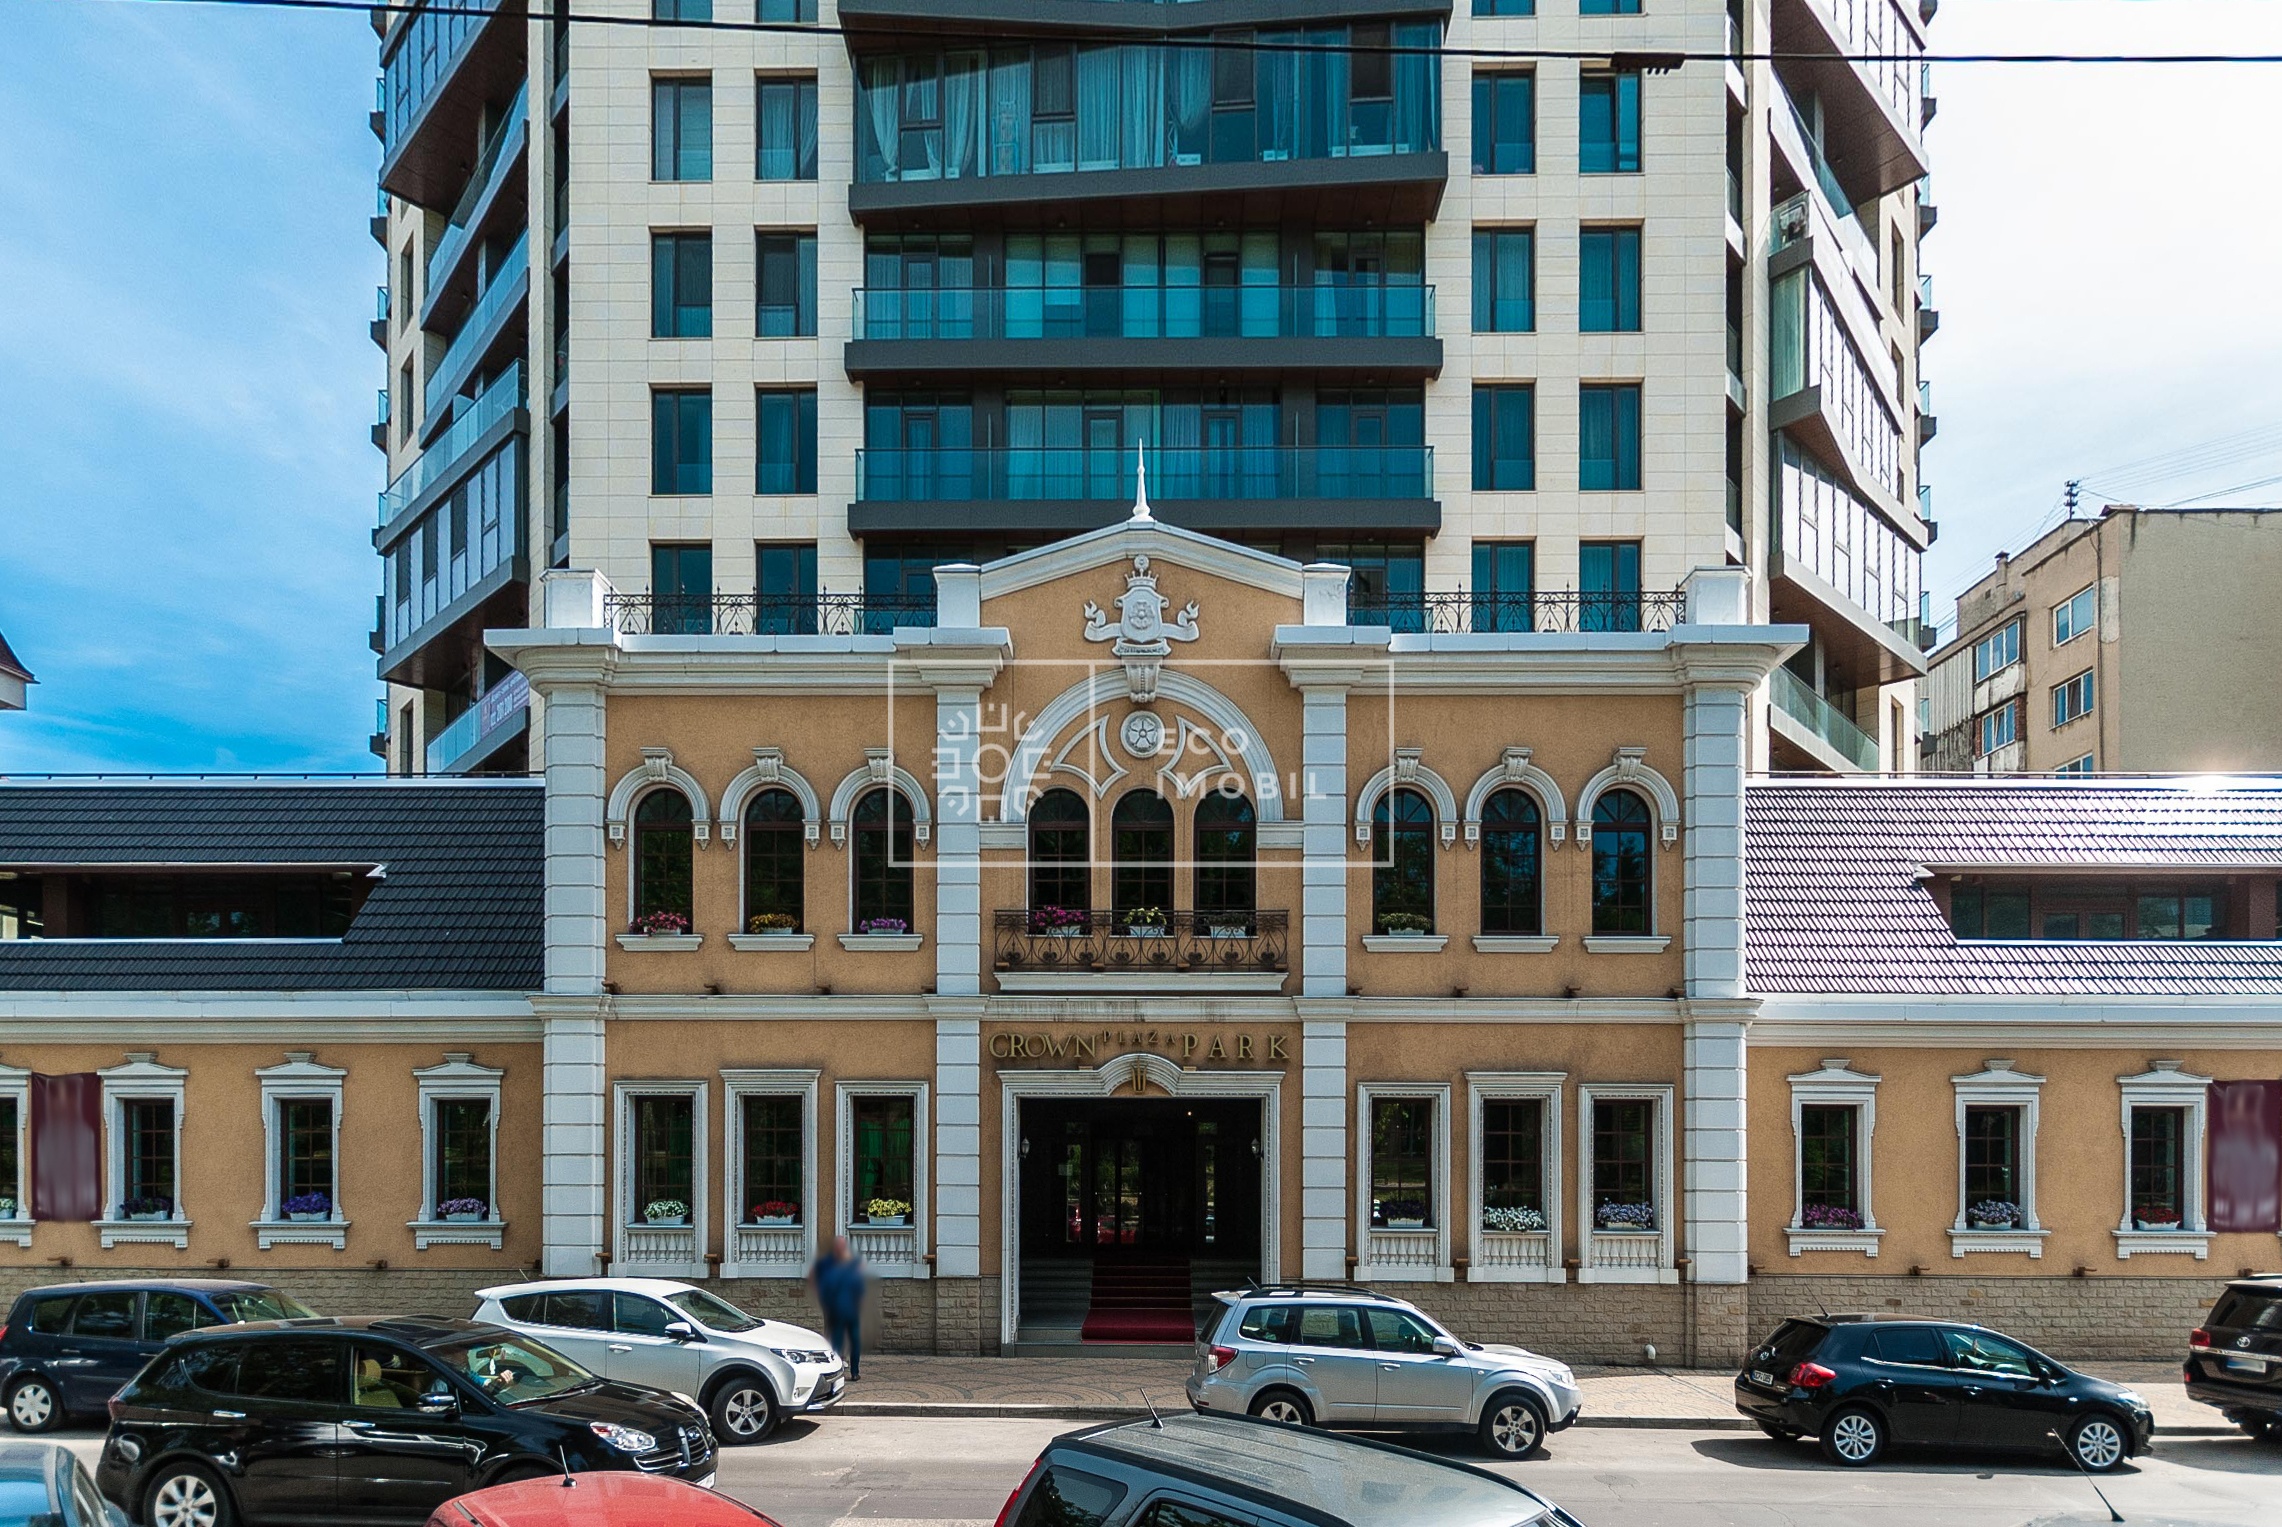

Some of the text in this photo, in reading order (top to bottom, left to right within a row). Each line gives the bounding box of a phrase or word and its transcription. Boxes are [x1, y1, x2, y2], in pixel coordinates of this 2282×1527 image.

[988, 1029, 1291, 1060] CROWN PLAZA PARK
